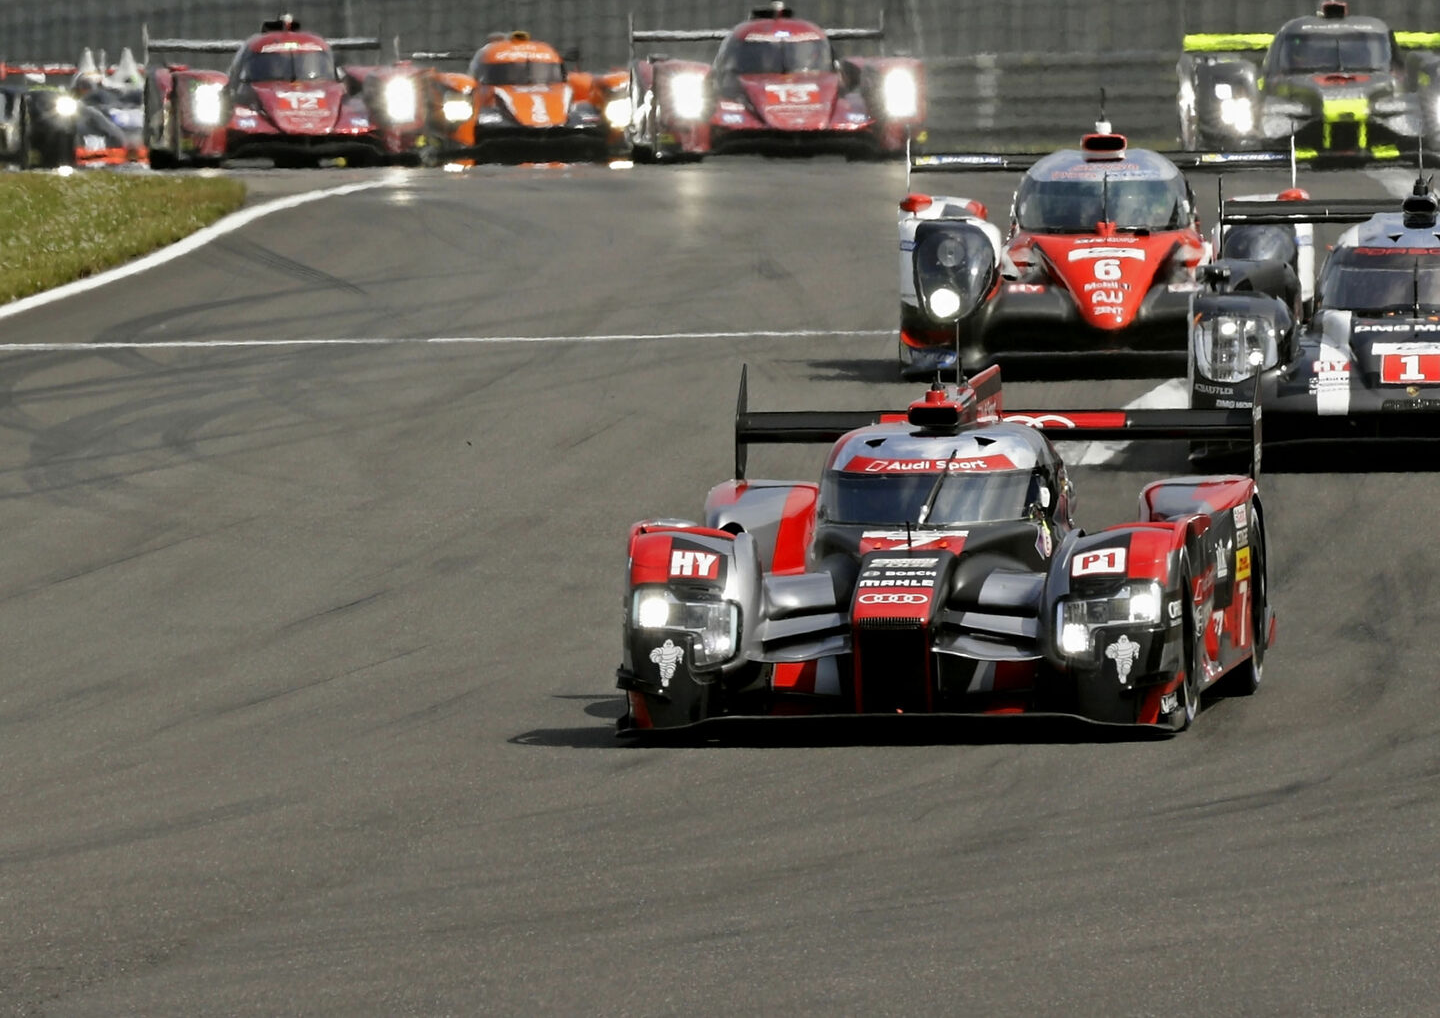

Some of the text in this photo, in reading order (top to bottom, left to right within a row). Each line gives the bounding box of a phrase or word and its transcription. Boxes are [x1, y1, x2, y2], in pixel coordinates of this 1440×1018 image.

[1094, 259, 1122, 281] 6
[1354, 324, 1410, 333] DMG
[1400, 355, 1425, 380] 1
[886, 459, 988, 471] Audi Sport
[670, 551, 717, 576] HY
[1081, 552, 1116, 570] P1
[859, 579, 934, 587] MAHLE
[1239, 580, 1248, 646] 7
